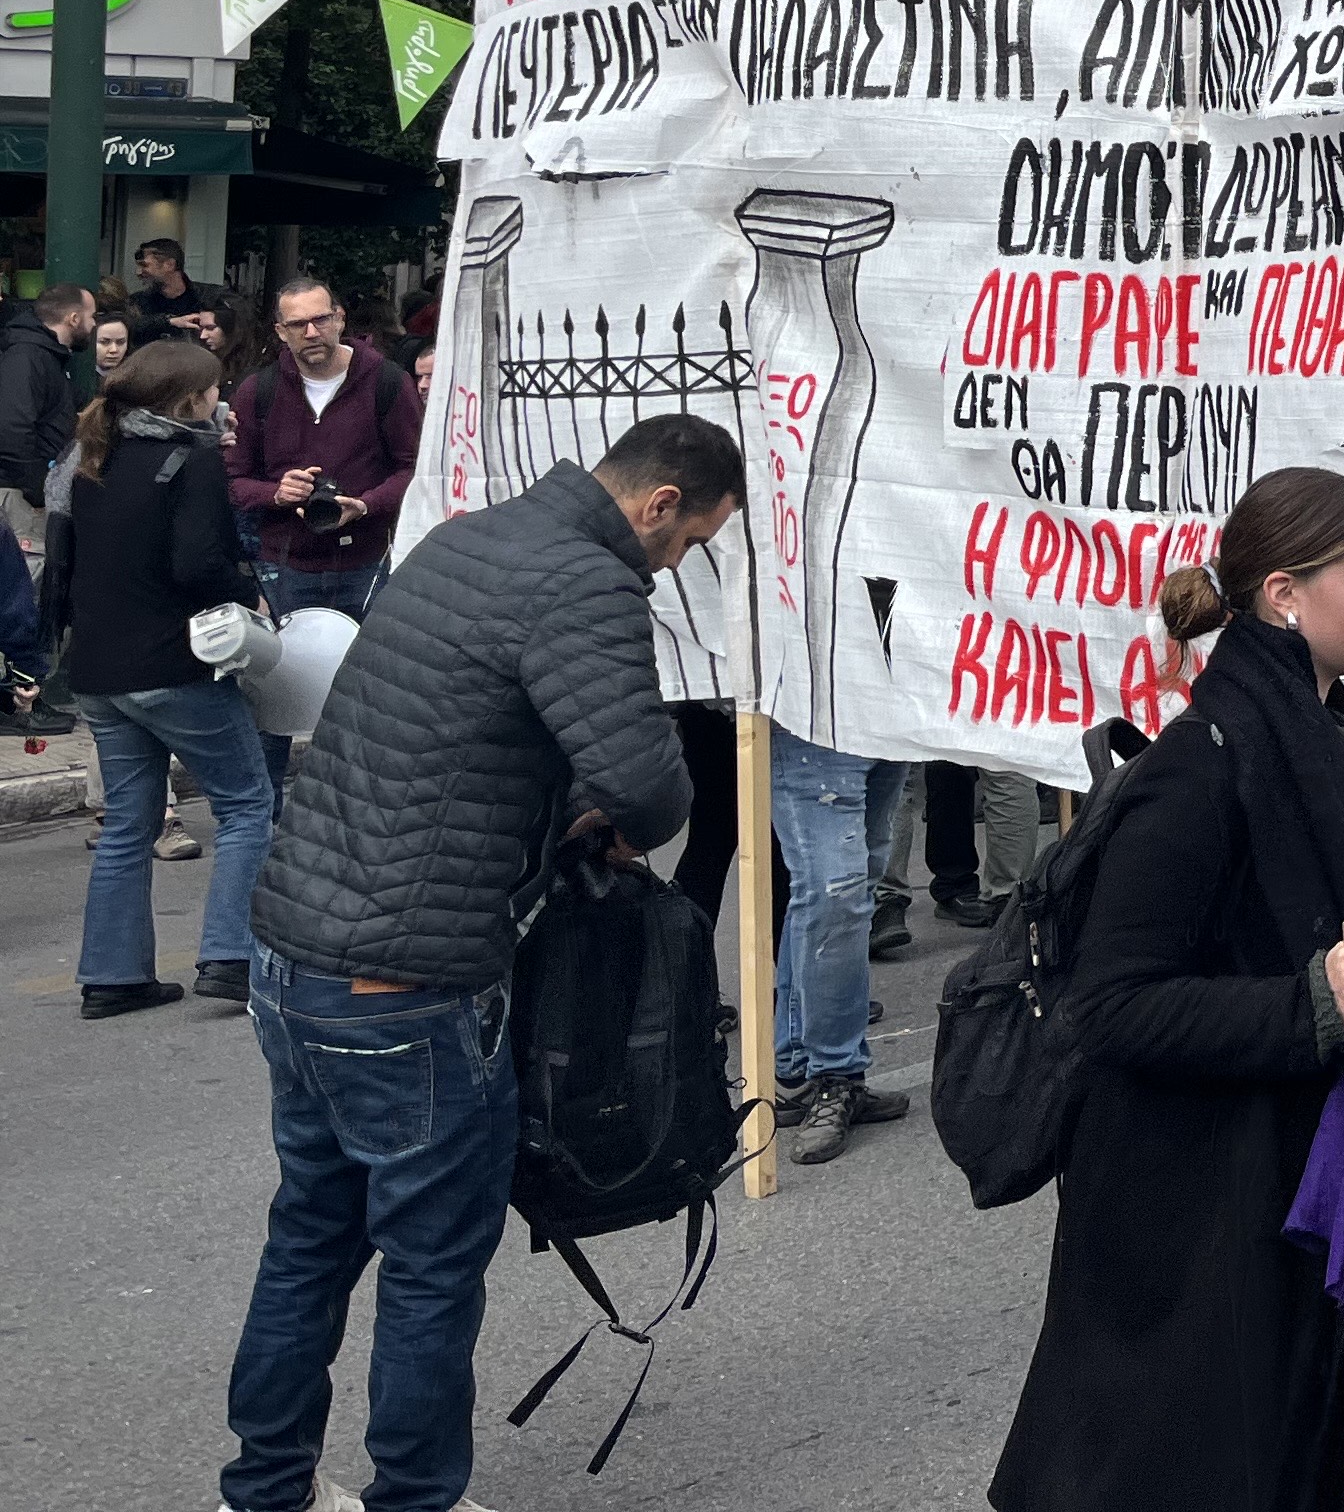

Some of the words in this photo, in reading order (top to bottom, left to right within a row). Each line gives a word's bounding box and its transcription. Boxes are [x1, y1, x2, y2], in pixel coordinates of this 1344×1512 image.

[472, 3, 660, 140] ΛΕΥΤΕΡΙΑ
[1204, 268, 1249, 321] ΚΑΙ
[952, 371, 1029, 430] ΔΕΝ
[1011, 438, 1066, 506] ΘΑ
[964, 501, 1009, 601] Η
[949, 611, 1096, 729] ΚΑΙΕΙ
